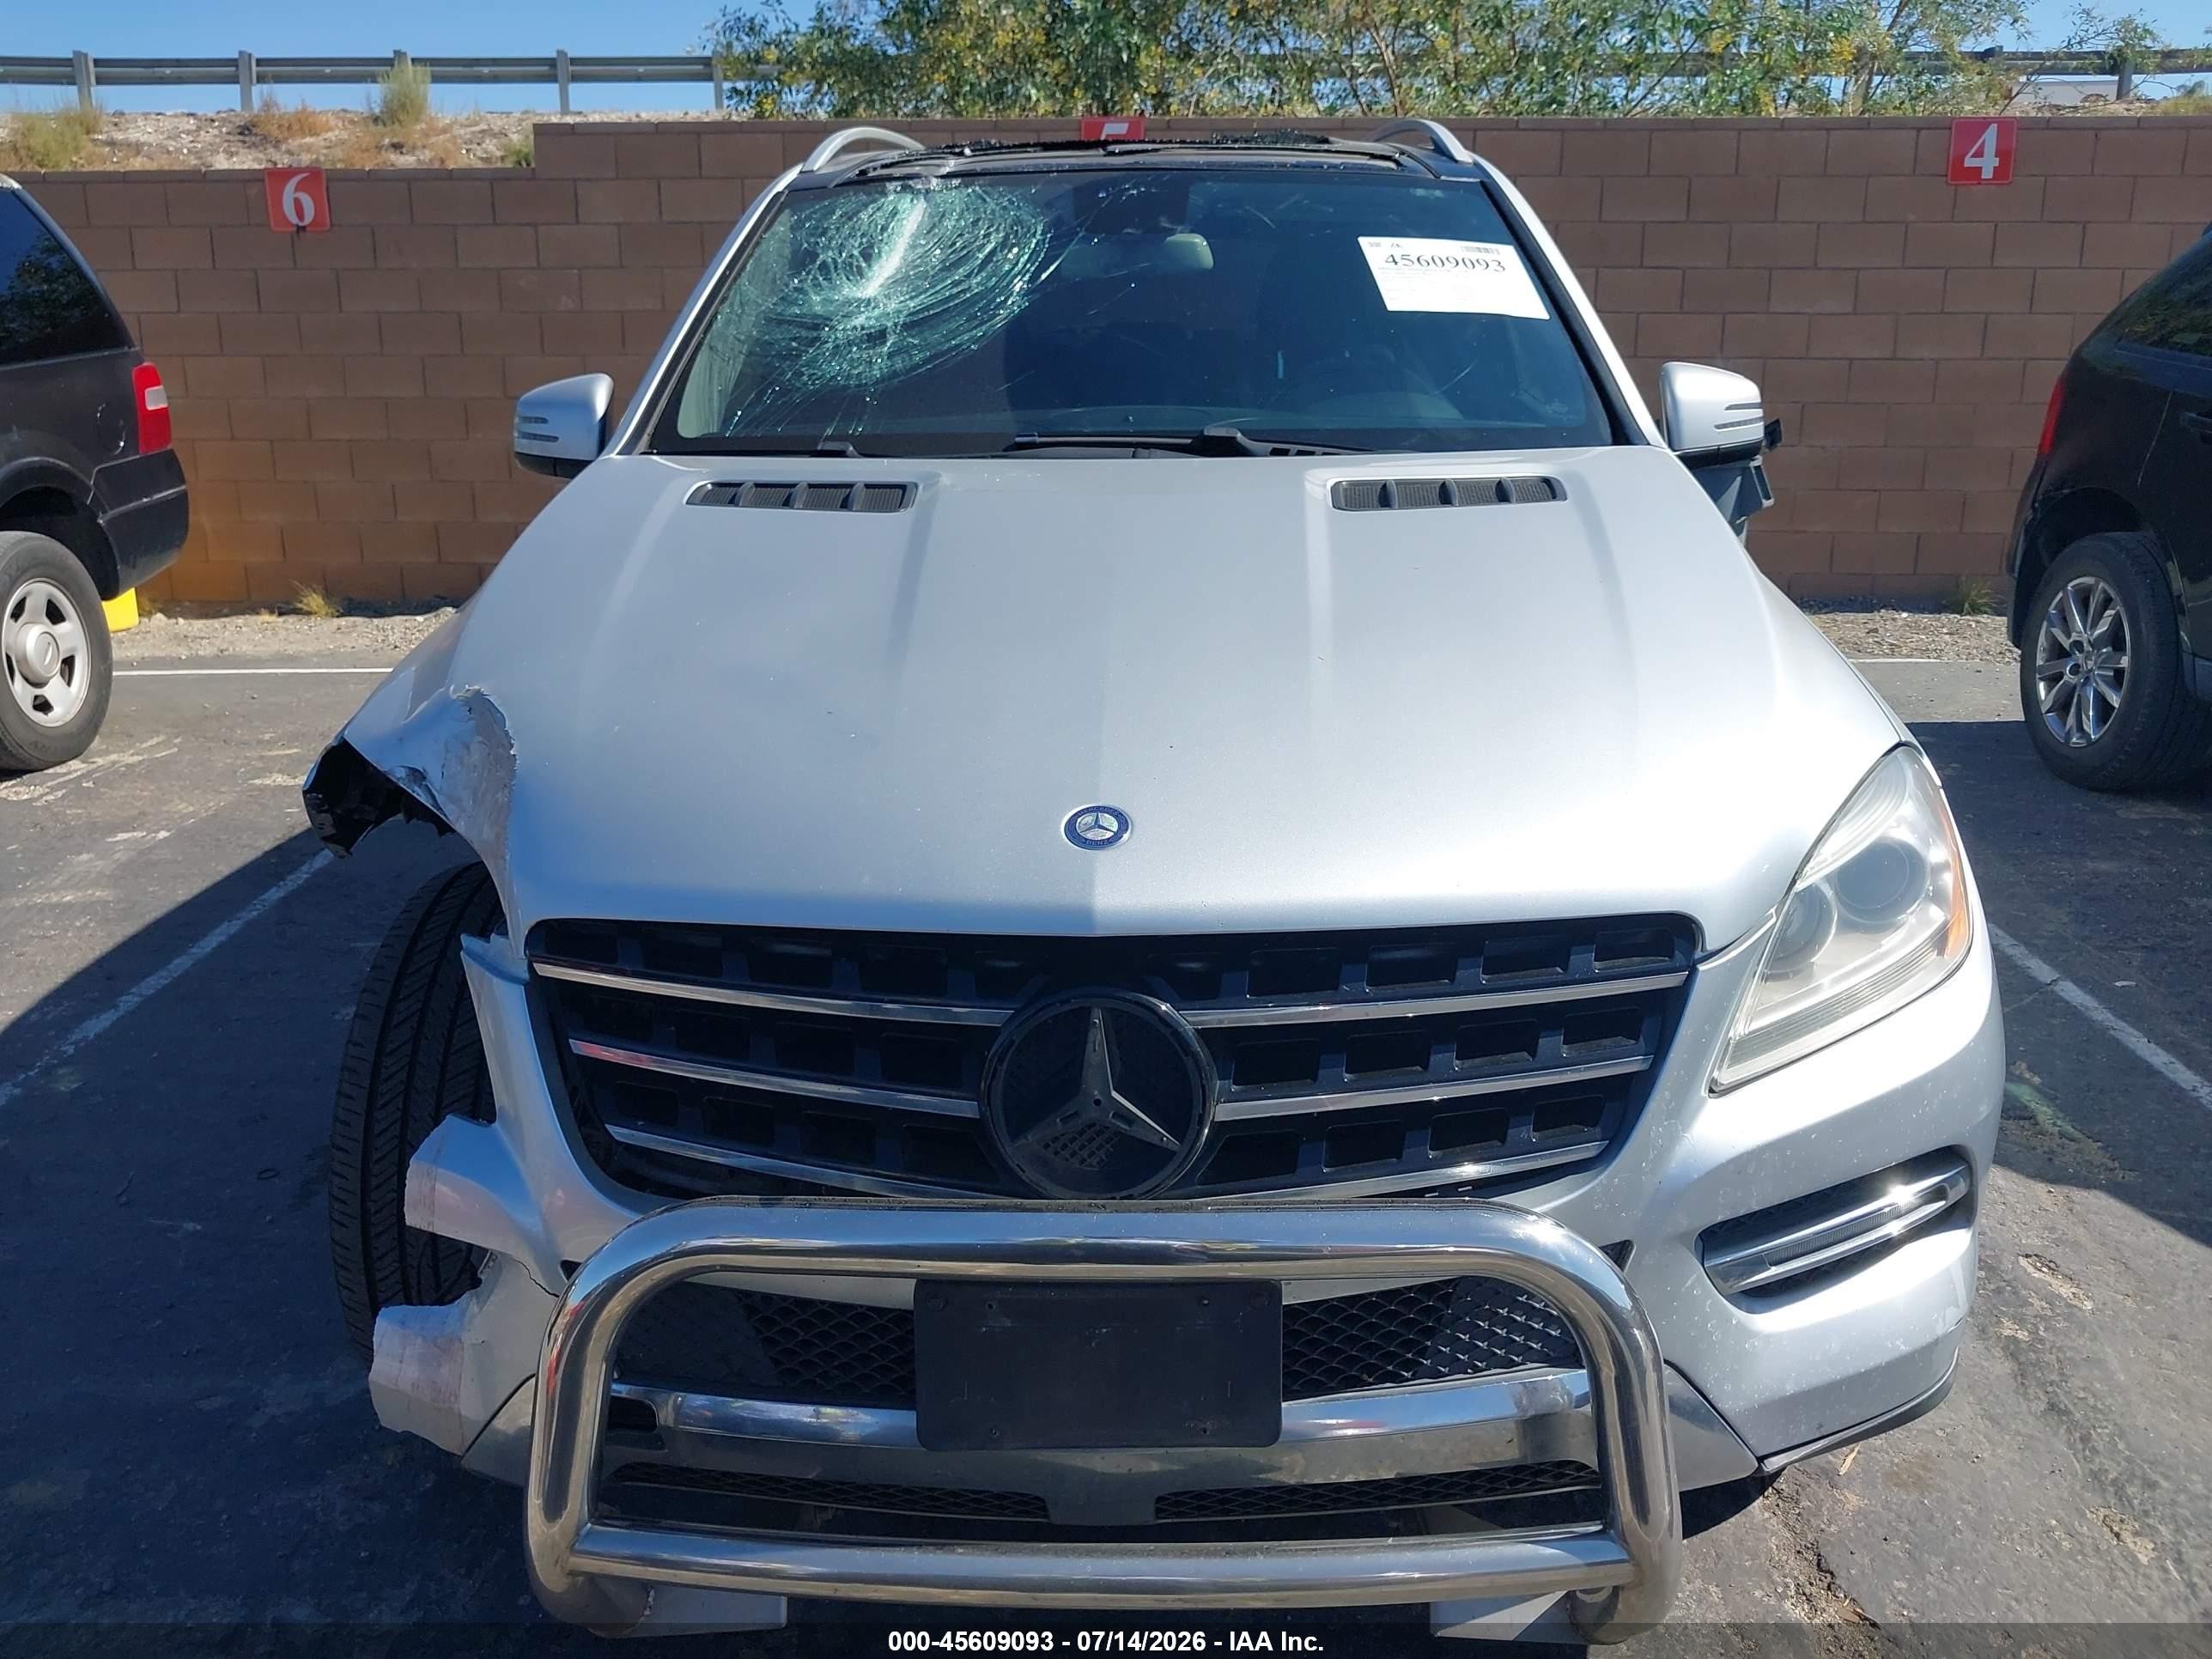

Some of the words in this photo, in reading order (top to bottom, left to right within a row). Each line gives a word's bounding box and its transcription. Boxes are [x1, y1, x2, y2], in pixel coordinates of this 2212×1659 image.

[1964, 123, 2000, 179] 4
[282, 172, 315, 227] 6
[1384, 253, 1506, 273] 45609093
